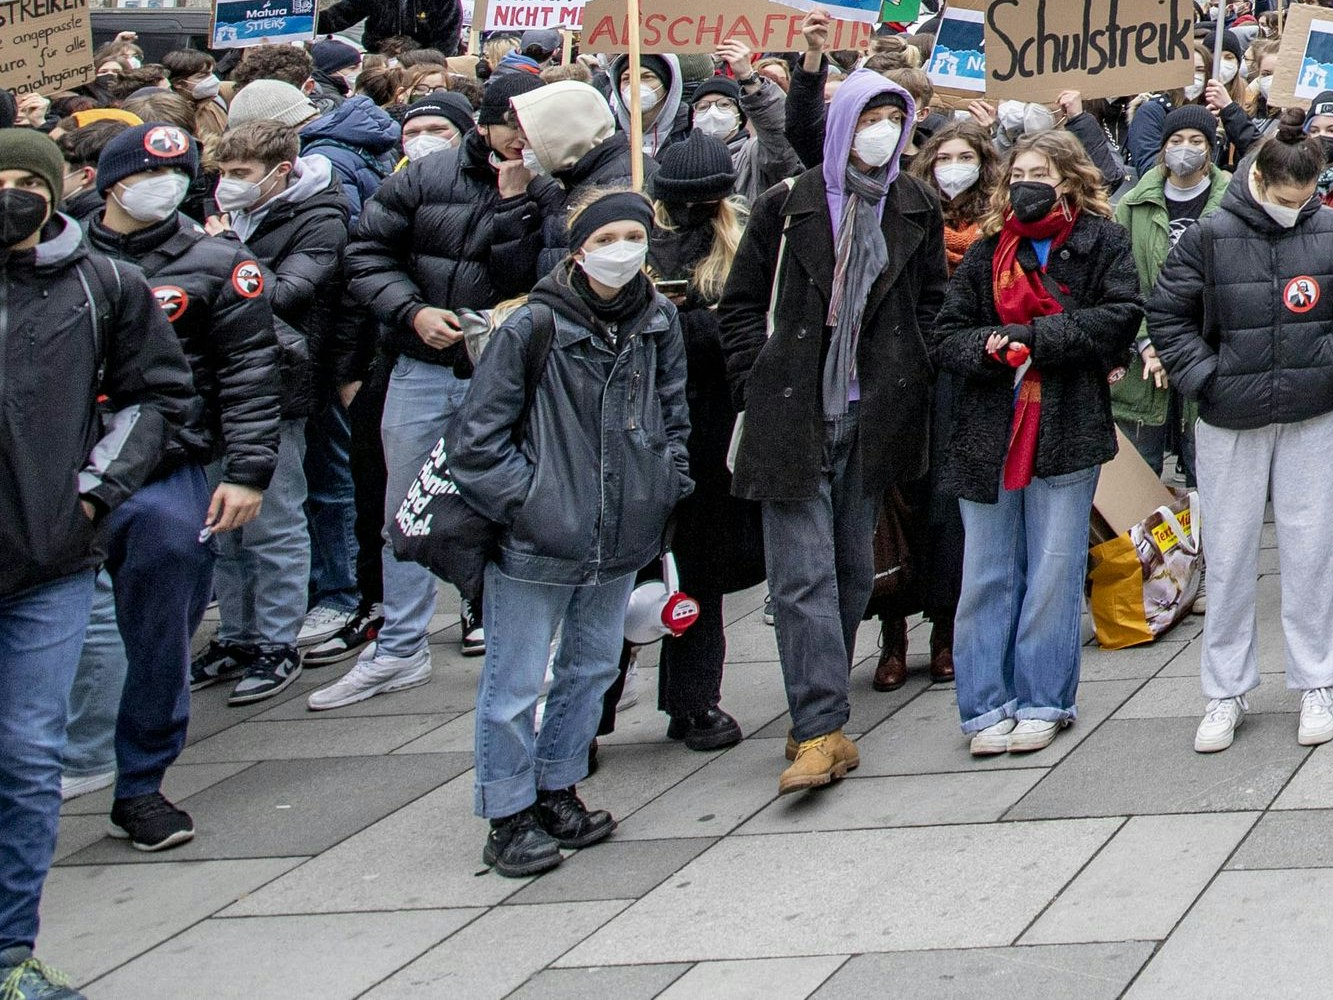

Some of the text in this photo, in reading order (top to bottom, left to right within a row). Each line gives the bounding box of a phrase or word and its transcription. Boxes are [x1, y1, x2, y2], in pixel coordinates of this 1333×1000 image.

[246, 7, 287, 20] Matura
[494, 5, 553, 27] NICHT
[13, 13, 83, 49] angepasste
[38, 36, 86, 68] für alle
[1155, 525, 1174, 542] Text
